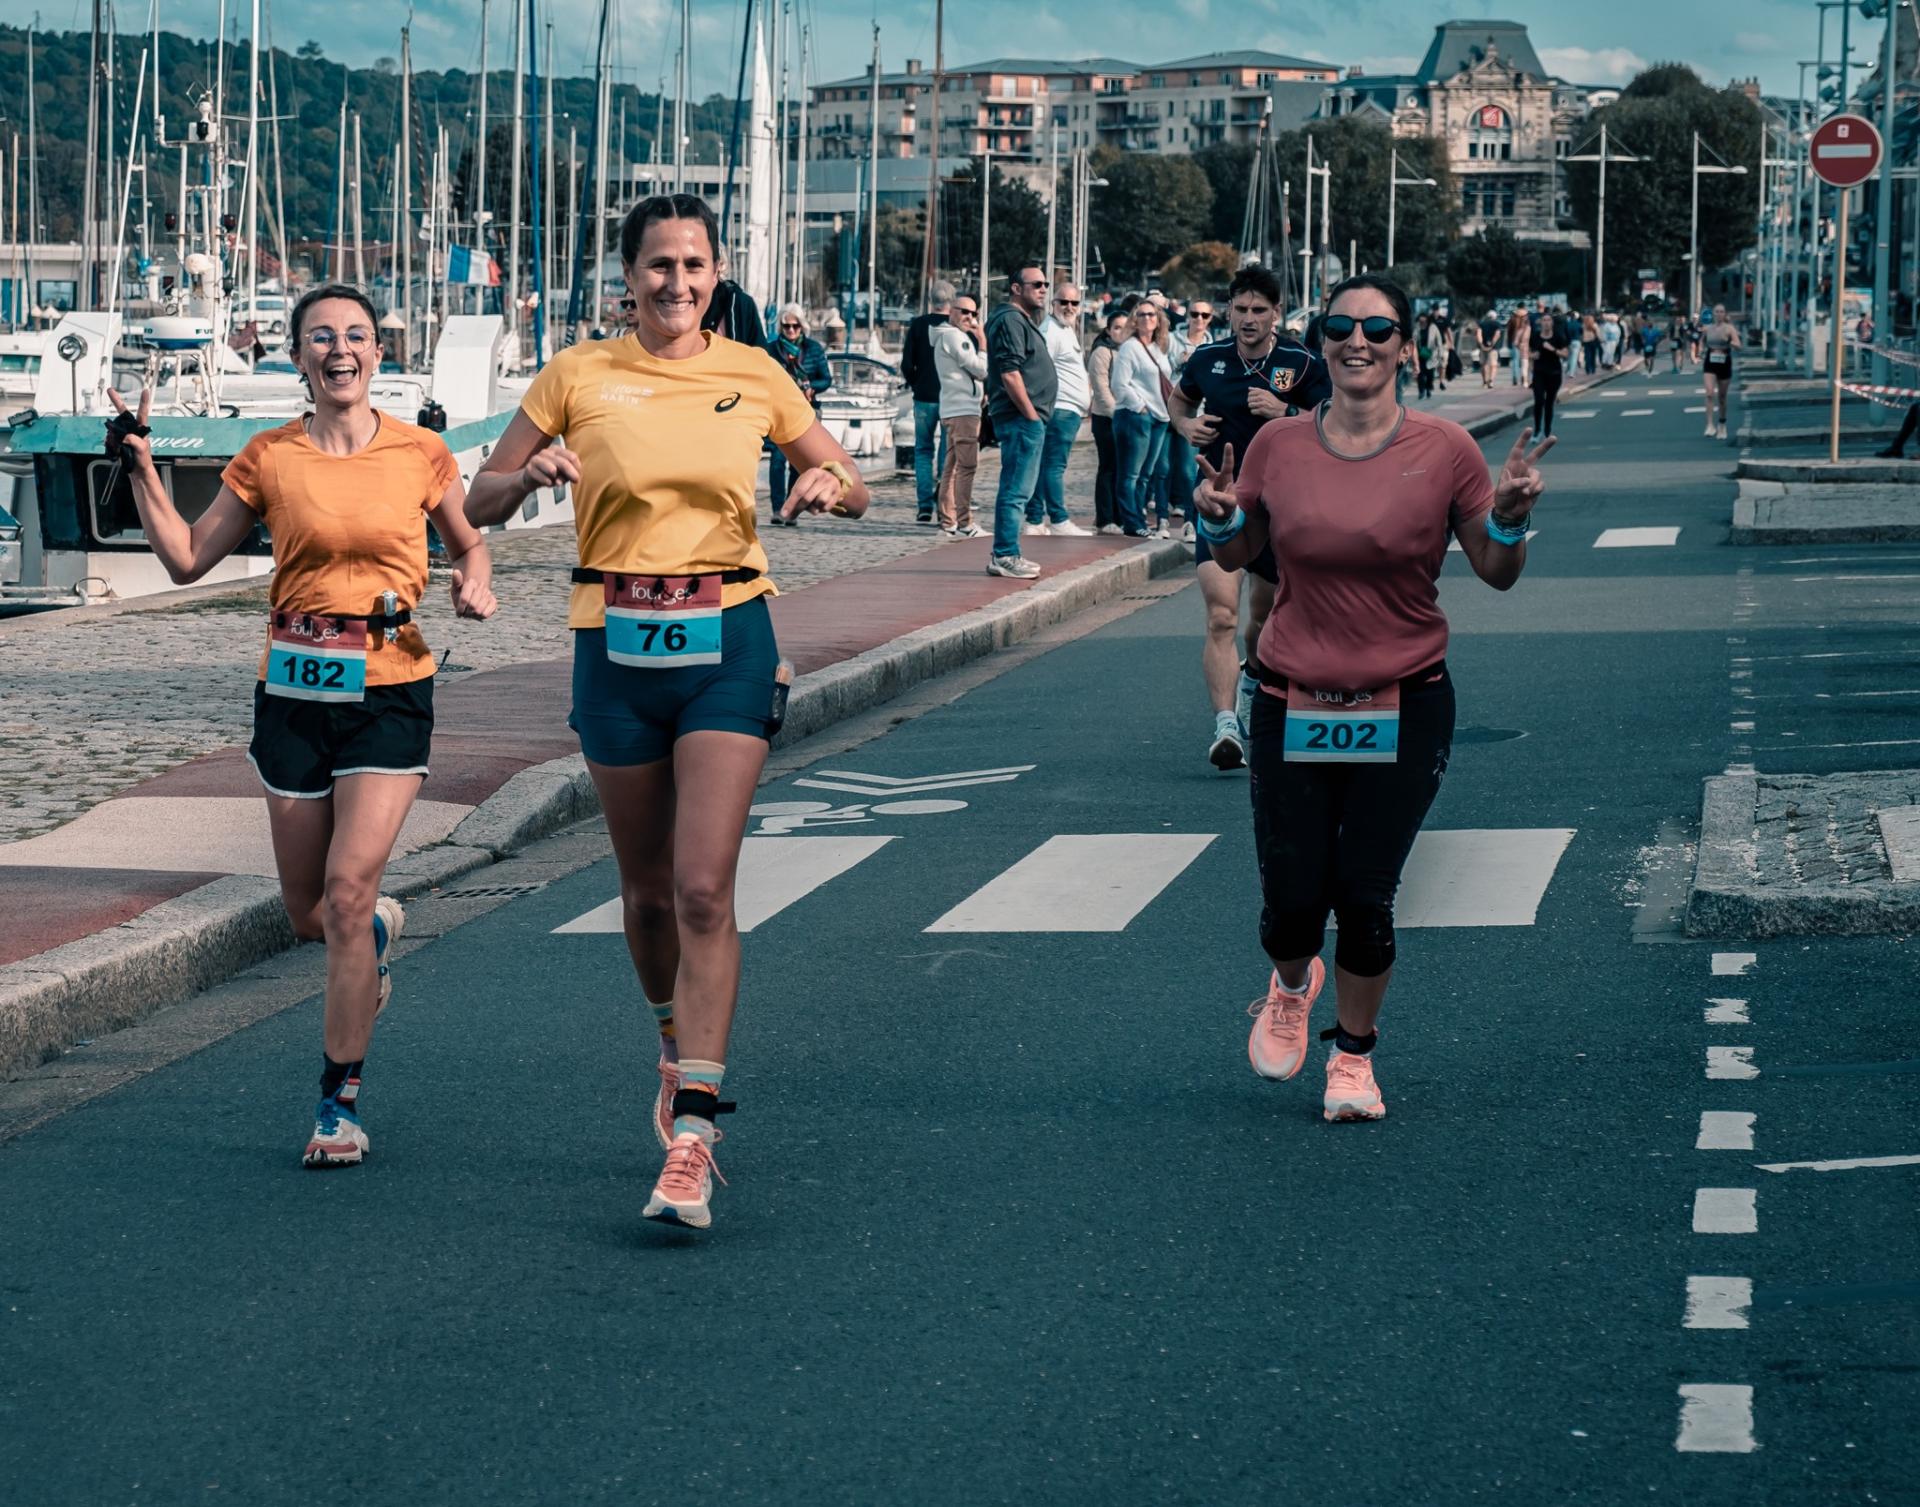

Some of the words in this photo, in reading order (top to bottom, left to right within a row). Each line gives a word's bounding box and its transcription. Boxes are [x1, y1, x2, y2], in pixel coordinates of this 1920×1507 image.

[637, 623, 687, 652] 76
[283, 656, 345, 688] 182
[1305, 723, 1377, 750] 202
